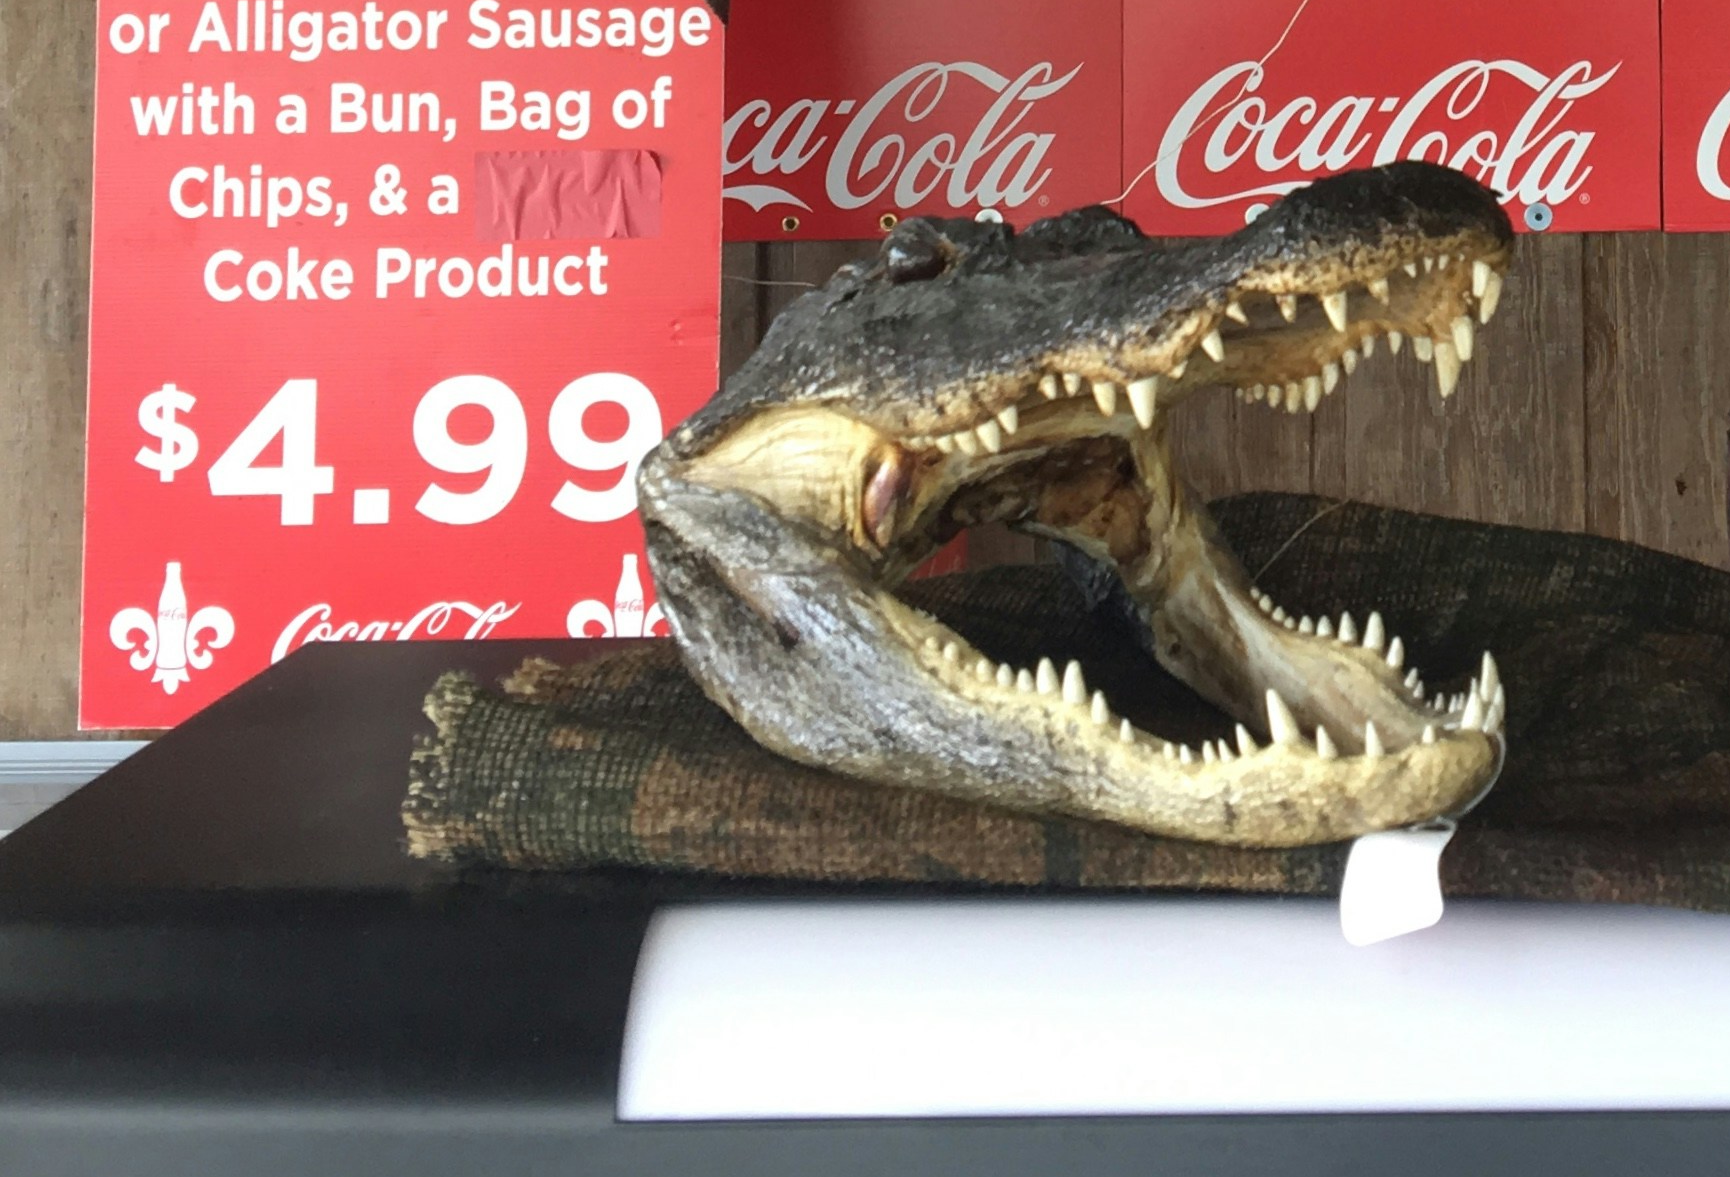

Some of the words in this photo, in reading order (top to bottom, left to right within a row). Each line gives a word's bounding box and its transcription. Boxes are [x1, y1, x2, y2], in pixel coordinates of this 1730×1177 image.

[110, 14, 170, 53] or
[189, 0, 447, 62] Alligator
[130, 82, 254, 135] with
[276, 95, 306, 134] a
[331, 83, 456, 142] Bun,
[481, 81, 590, 140] Bag
[613, 76, 672, 129] of
[722, 62, 1084, 212] ca-Cola
[1154, 59, 1624, 210] Coca-Cola
[170, 165, 347, 227] Chips,
[369, 164, 407, 215] &
[428, 175, 458, 214] a
[204, 247, 353, 301] Coke
[377, 244, 608, 298] Product
[134, 372, 663, 526] $4.99
